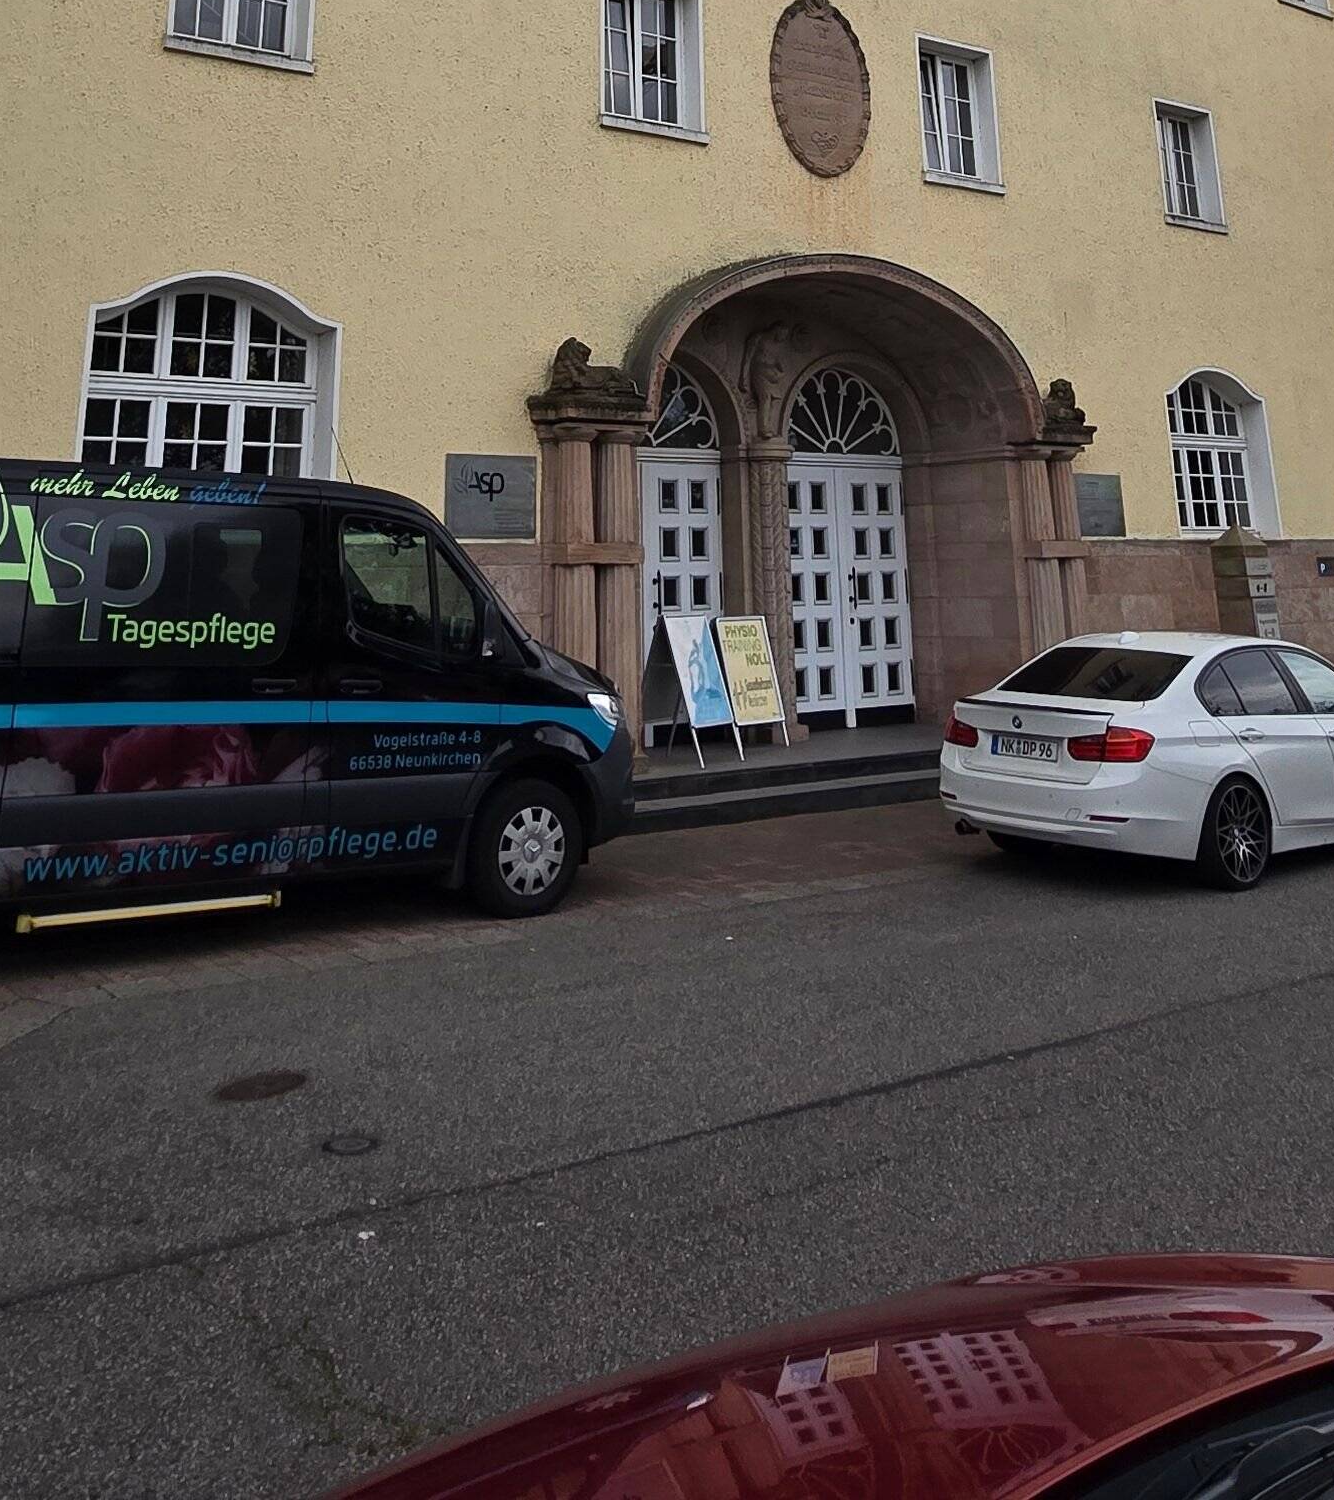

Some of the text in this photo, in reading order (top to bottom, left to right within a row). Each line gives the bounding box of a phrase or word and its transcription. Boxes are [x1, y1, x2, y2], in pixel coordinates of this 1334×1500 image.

[30, 468, 96, 498] mehr
[102, 471, 180, 502] Leben
[188, 477, 266, 510] geben!
[107, 612, 276, 650] Tagespflege
[724, 624, 758, 638] PHYSIO
[723, 638, 763, 653] TRAINING
[745, 652, 771, 666] NOLL
[373, 730, 481, 750] Vogelstraße 4-8
[1000, 738, 1053, 758] NK DP 96
[349, 752, 482, 771] 66538 Neunkirchen
[24, 823, 438, 884] www.aktiv-seniorpflege.de
